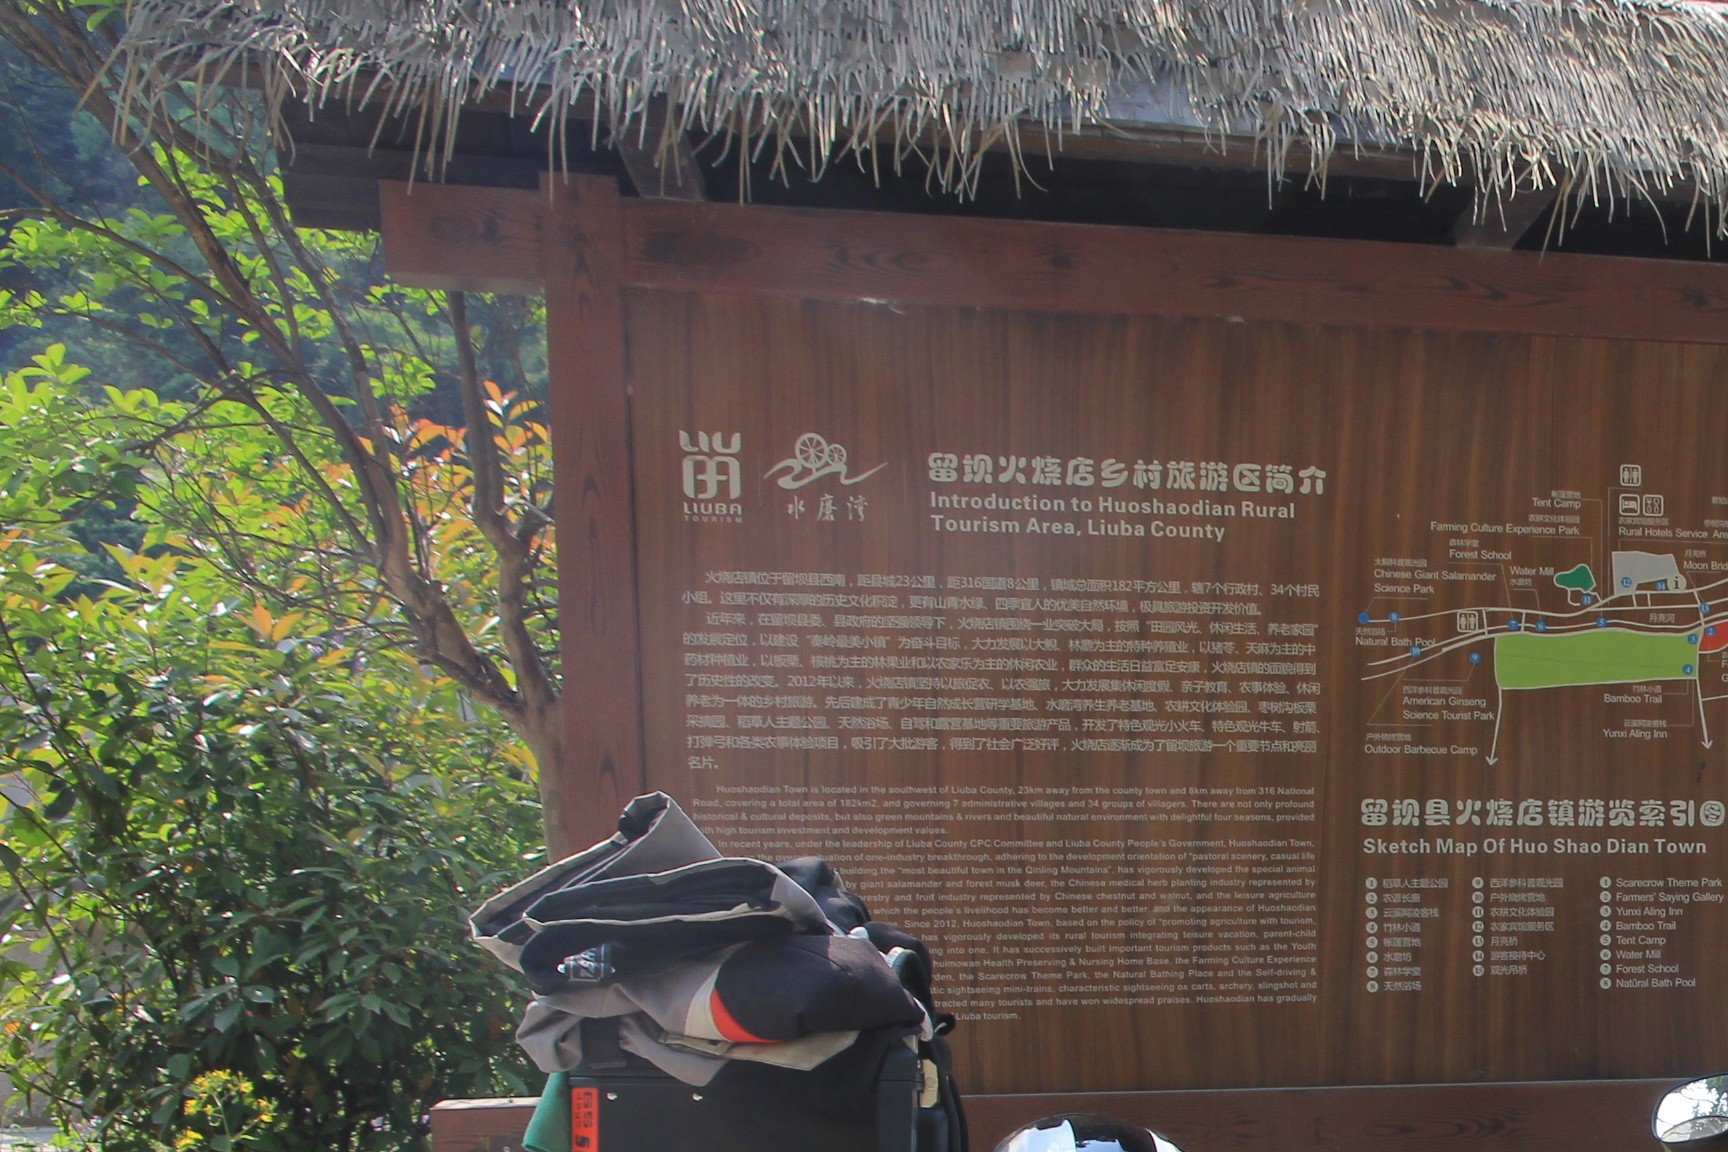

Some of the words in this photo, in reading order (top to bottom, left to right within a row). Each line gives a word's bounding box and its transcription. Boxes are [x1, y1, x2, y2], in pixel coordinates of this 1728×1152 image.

[928, 451, 1327, 496] 留坝火烧店乡村旅游区简介
[683, 501, 742, 515] LIUBA
[787, 493, 868, 522] 水磨湾
[931, 492, 1064, 510] Introduction
[1071, 498, 1092, 511] to
[1099, 497, 1235, 516] Huoshaodian
[1242, 502, 1294, 518] Rural
[684, 514, 743, 523] TOURISM
[931, 515, 1019, 532] Tourism
[1027, 518, 1081, 536] Area,
[1088, 520, 1144, 536] Liuba
[1151, 521, 1224, 542] County
[1431, 521, 1468, 533] Farming
[1471, 523, 1503, 532] Culture
[1506, 524, 1555, 534] Experience
[1559, 526, 1579, 534] Park
[1619, 527, 1642, 536] Rural
[1645, 528, 1672, 536] Hotels
[1676, 528, 1708, 538] Service
[1374, 569, 1411, 578] Chinese
[1415, 570, 1439, 579] Giant
[1442, 571, 1496, 581] Salamander
[1374, 583, 1410, 592] Science
[1414, 584, 1434, 593] Park
[1649, 612, 1675, 624] 月亮河
[1356, 637, 1388, 645] Natural
[1391, 637, 1413, 647] Bath
[1415, 638, 1436, 647] Pool
[1603, 729, 1627, 737] Yunxi
[1629, 729, 1650, 740] Aling
[1654, 730, 1667, 738] Inn
[1365, 744, 1401, 753] Outdoor
[1404, 745, 1447, 754] Barbecue
[1450, 745, 1477, 756] Camp
[688, 756, 719, 770] 名片。
[1360, 798, 1726, 827] 留坝县火烧店镇游览索引图
[1364, 839, 1430, 853] Sketch
[1437, 839, 1477, 856] Map
[1484, 838, 1505, 853] Of
[1511, 839, 1548, 853] Huo
[1554, 839, 1601, 853] Shao
[1608, 839, 1648, 853] Dian
[1654, 839, 1706, 853] Town
[1616, 878, 1664, 887] Scarecrow
[1667, 878, 1698, 886] Theme
[1702, 878, 1722, 886] Park
[1617, 893, 1656, 901] Farmers'
[1659, 892, 1689, 903] Saying
[1692, 892, 1724, 903] Gallery
[1617, 908, 1641, 916] Yunxi
[1644, 907, 1666, 918] Aling
[1669, 907, 1682, 915] Inn
[1616, 922, 1654, 930] Bamboo
[1657, 921, 1676, 930] Trail
[1616, 936, 1635, 944] Tent
[1638, 936, 1666, 946] Camp
[1616, 950, 1642, 958] Water
[1646, 950, 1660, 958] Mill
